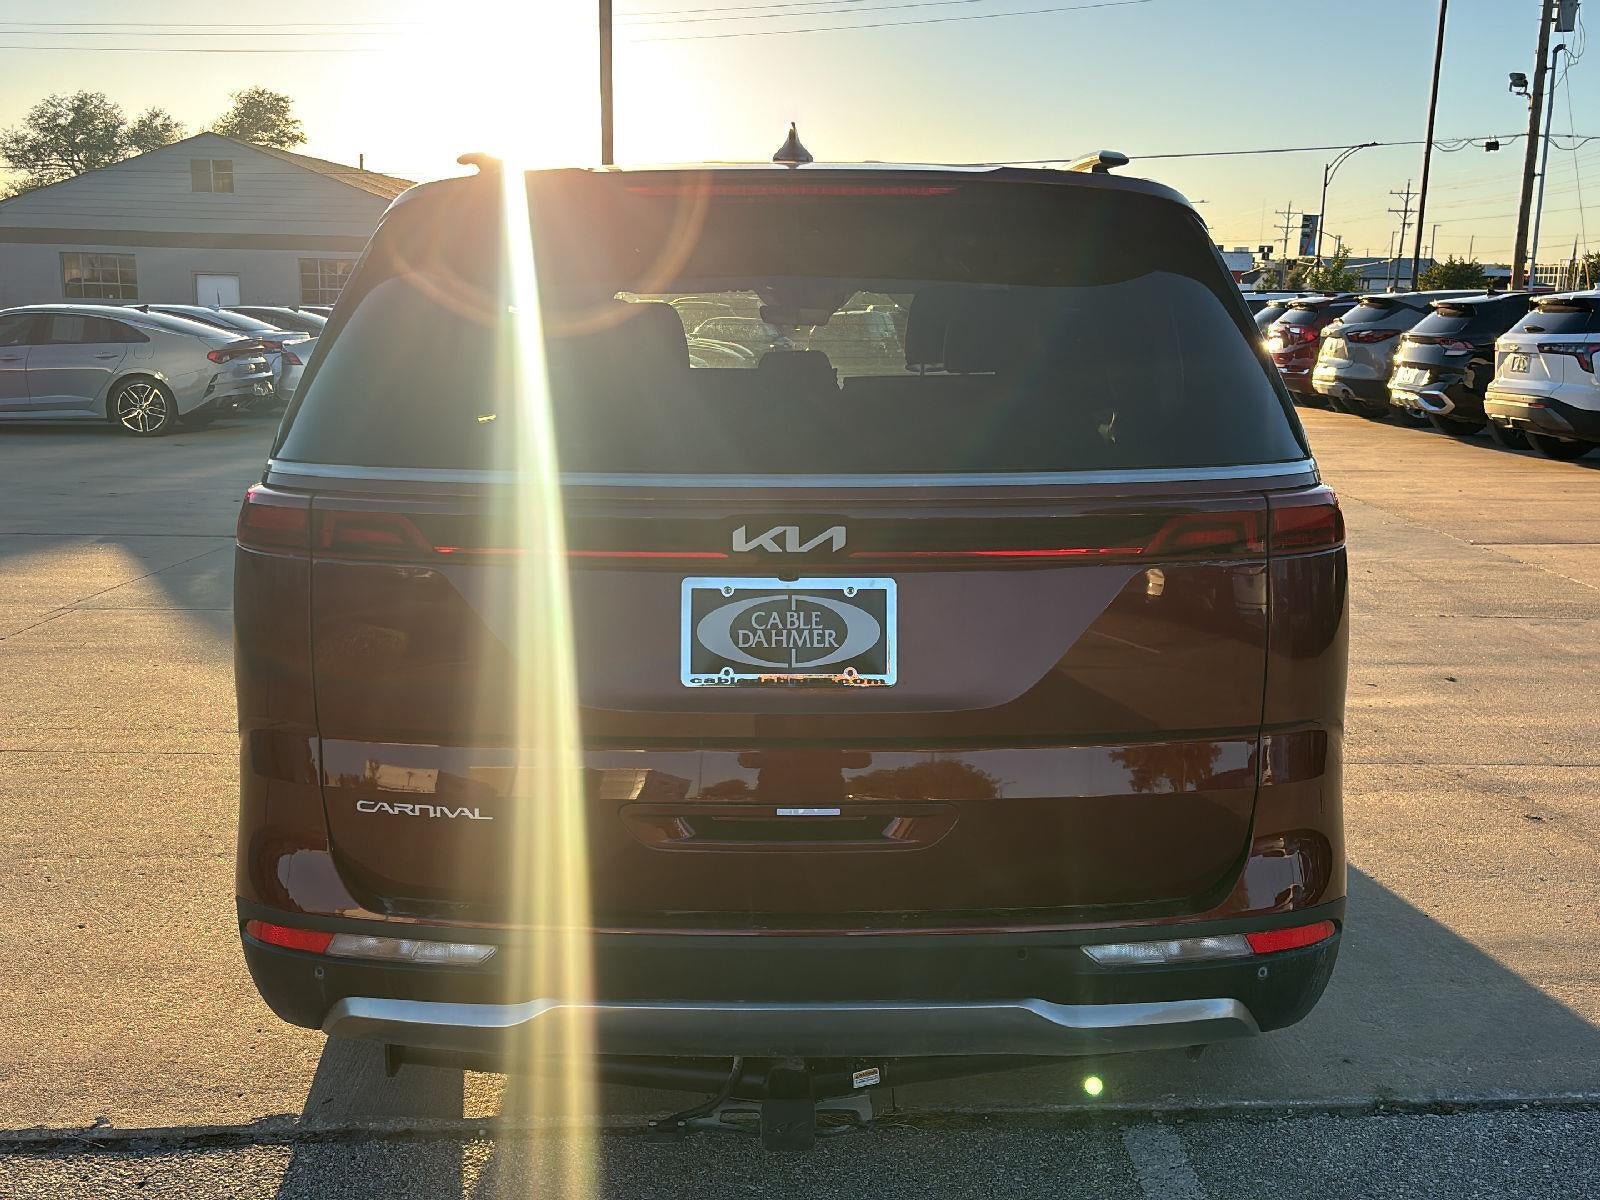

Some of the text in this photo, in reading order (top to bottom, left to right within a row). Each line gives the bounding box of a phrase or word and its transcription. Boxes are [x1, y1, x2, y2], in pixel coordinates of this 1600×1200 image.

[732, 525, 847, 553] KIA
[751, 611, 824, 630] CABLE
[738, 629, 840, 648] DAHMER
[356, 800, 494, 820] CARNIVAL
